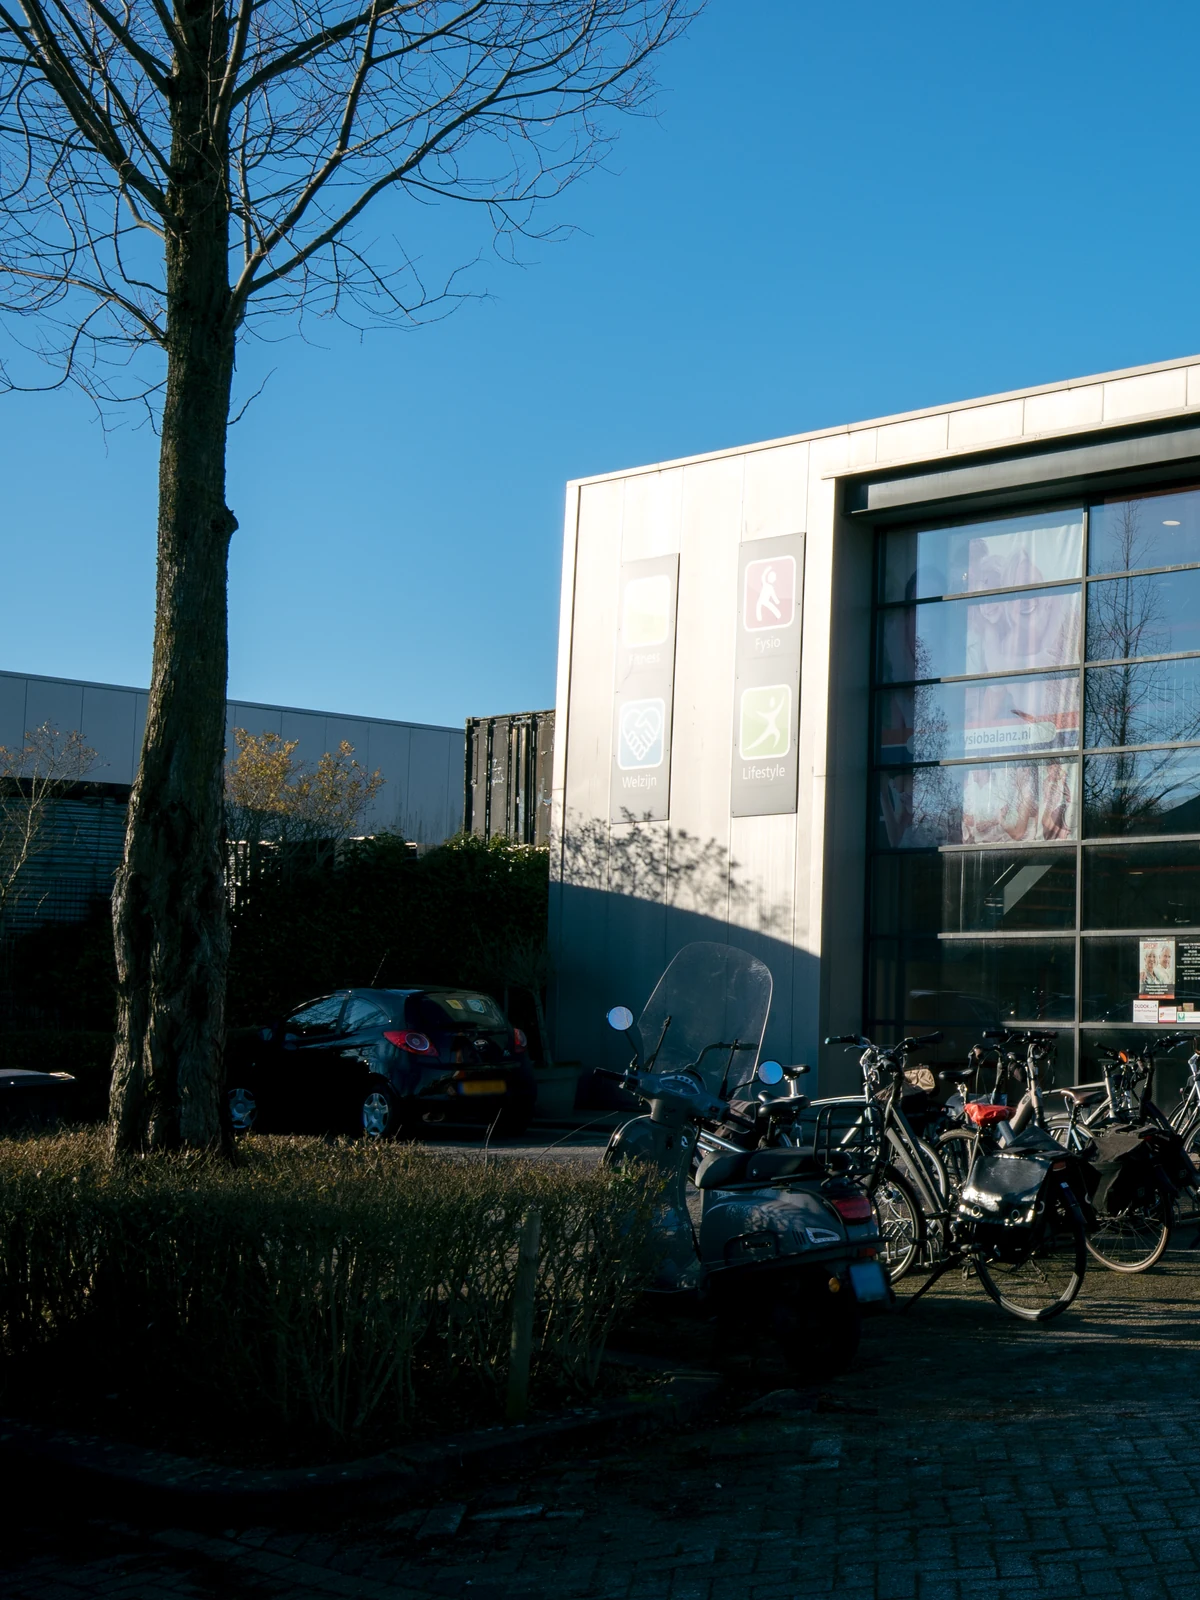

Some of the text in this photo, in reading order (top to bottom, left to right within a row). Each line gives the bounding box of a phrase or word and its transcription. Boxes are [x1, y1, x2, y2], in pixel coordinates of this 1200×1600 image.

[755, 635, 781, 653] Fysio
[742, 763, 786, 781] Lifestyle
[622, 774, 657, 790] Welzijn
